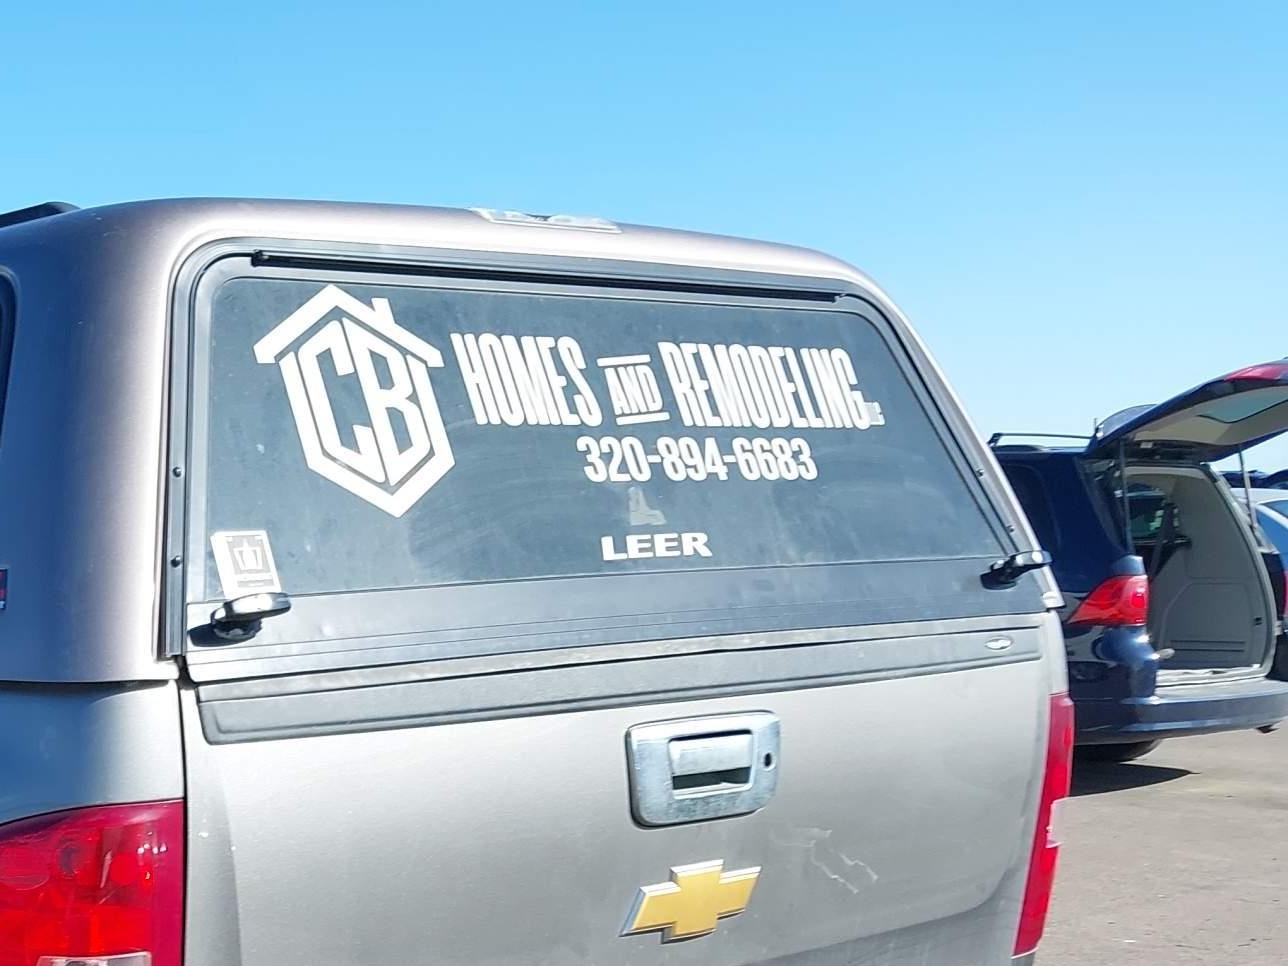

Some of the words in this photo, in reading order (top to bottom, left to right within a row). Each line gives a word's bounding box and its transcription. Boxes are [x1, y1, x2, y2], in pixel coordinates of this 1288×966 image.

[450, 333, 603, 427] HOMES
[604, 364, 663, 416] AND
[657, 341, 871, 430] REMODELING
[576, 435, 818, 483] 320-894-6683
[601, 532, 713, 561] LEER
